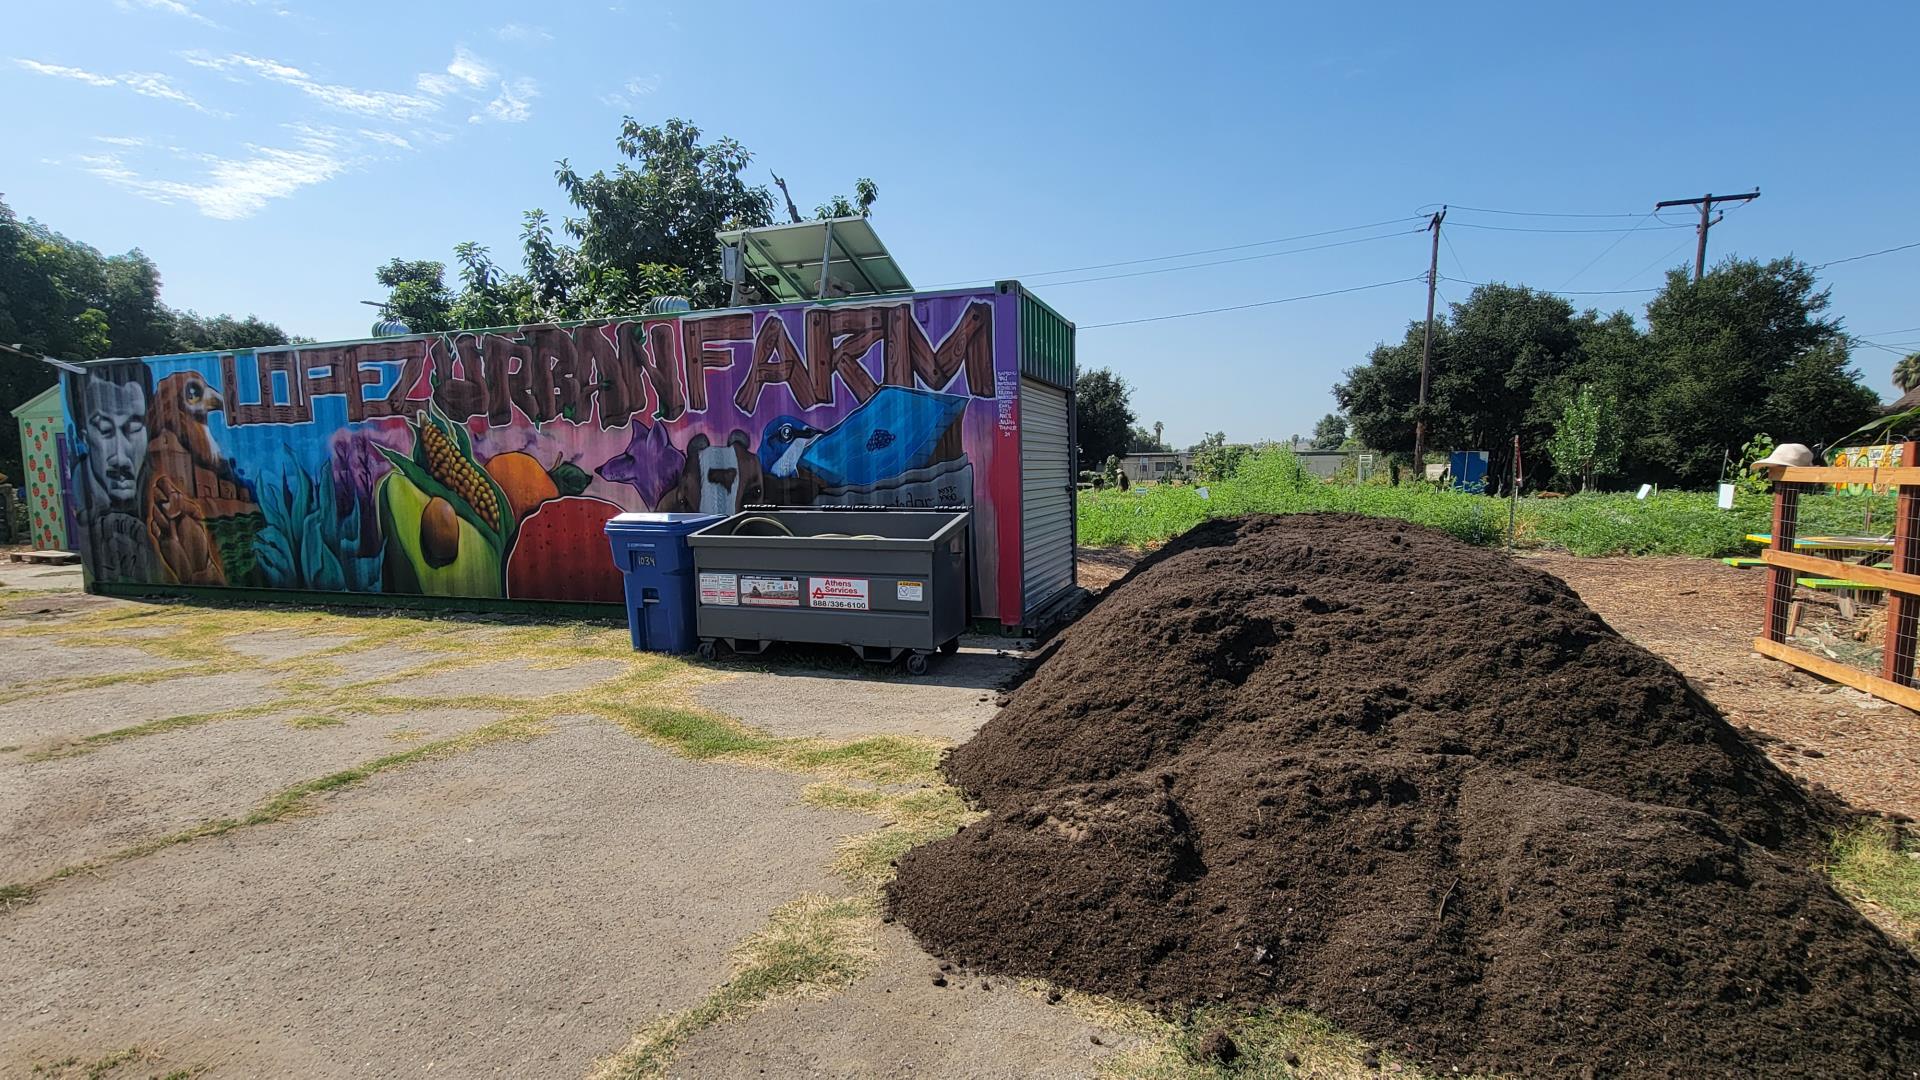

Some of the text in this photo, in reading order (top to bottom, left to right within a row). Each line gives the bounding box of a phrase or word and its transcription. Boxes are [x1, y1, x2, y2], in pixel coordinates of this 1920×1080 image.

[221, 297, 997, 430] LOPEZ URBAN FARM
[638, 556, 656, 567] 1034
[824, 586, 858, 594] Services
[812, 599, 866, 609] 888/336-6100
